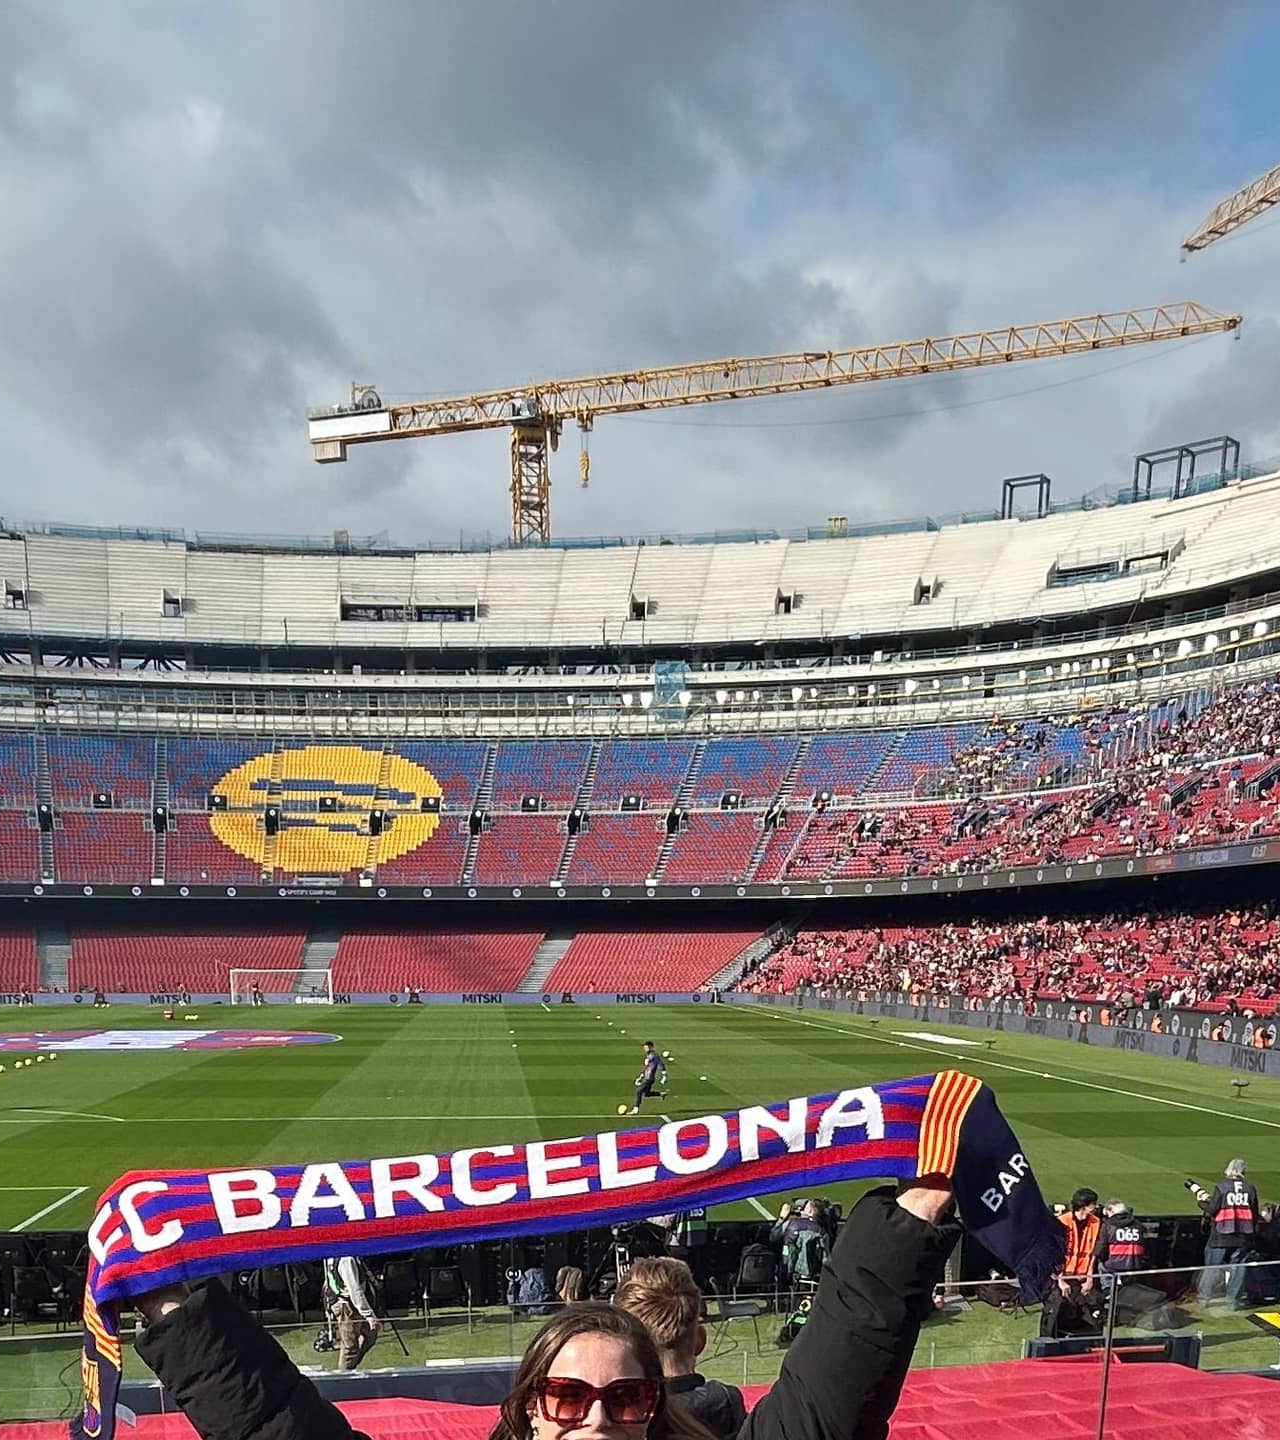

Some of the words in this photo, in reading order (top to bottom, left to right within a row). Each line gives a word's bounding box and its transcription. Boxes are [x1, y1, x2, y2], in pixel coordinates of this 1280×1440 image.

[462, 993, 502, 1004] MITSKI
[616, 993, 656, 1004] MITSKI
[1115, 1029, 1145, 1051] MITSKI
[1230, 1047, 1267, 1073] MITSKI
[87, 1180, 185, 1266] FC
[207, 1085, 886, 1236] BARCELONA
[980, 1152, 1029, 1212] BAR
[1115, 1228, 1140, 1241] 065
